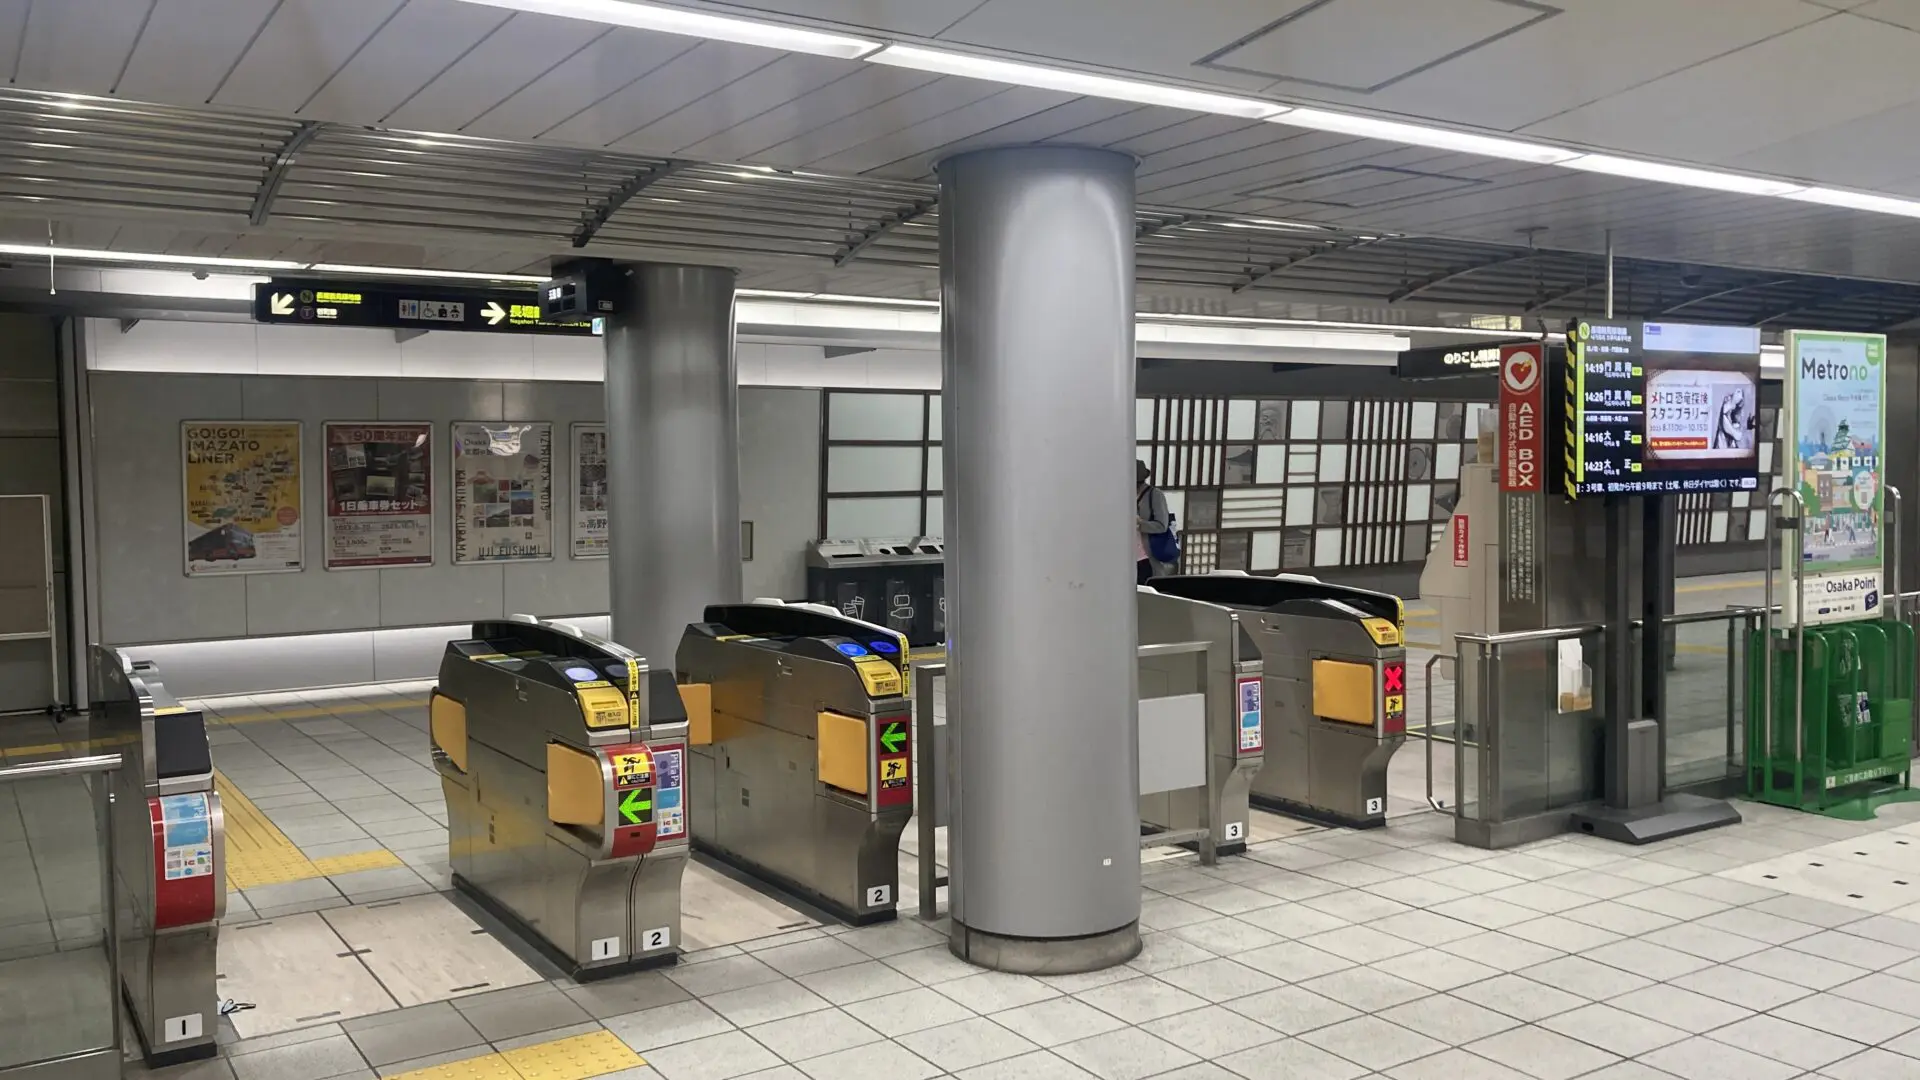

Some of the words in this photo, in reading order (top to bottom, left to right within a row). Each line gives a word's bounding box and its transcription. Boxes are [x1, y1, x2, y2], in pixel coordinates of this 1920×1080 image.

[1585, 363, 1604, 374] 14:19
[1801, 356, 1868, 381] Metrono
[1585, 391, 1604, 402] 14:26
[1651, 390, 1709, 405] メトロ恐竜探検
[1650, 407, 1709, 420] スタンプラリー
[1518, 402, 1534, 441] AED
[187, 428, 246, 440] GO!GO!
[1585, 432, 1604, 443] 14:16
[187, 440, 260, 452] IMAZATO
[187, 452, 235, 464] LINER
[1518, 448, 1534, 487] BOX
[1584, 461, 1604, 472] 14:23
[1826, 579, 1853, 593] Osaka
[1854, 577, 1876, 591] Point
[670, 752, 680, 787] PiTaPa
[1371, 801, 1378, 811] 3
[1231, 825, 1238, 837] 3
[874, 889, 884, 903] 2
[651, 931, 662, 946] 2
